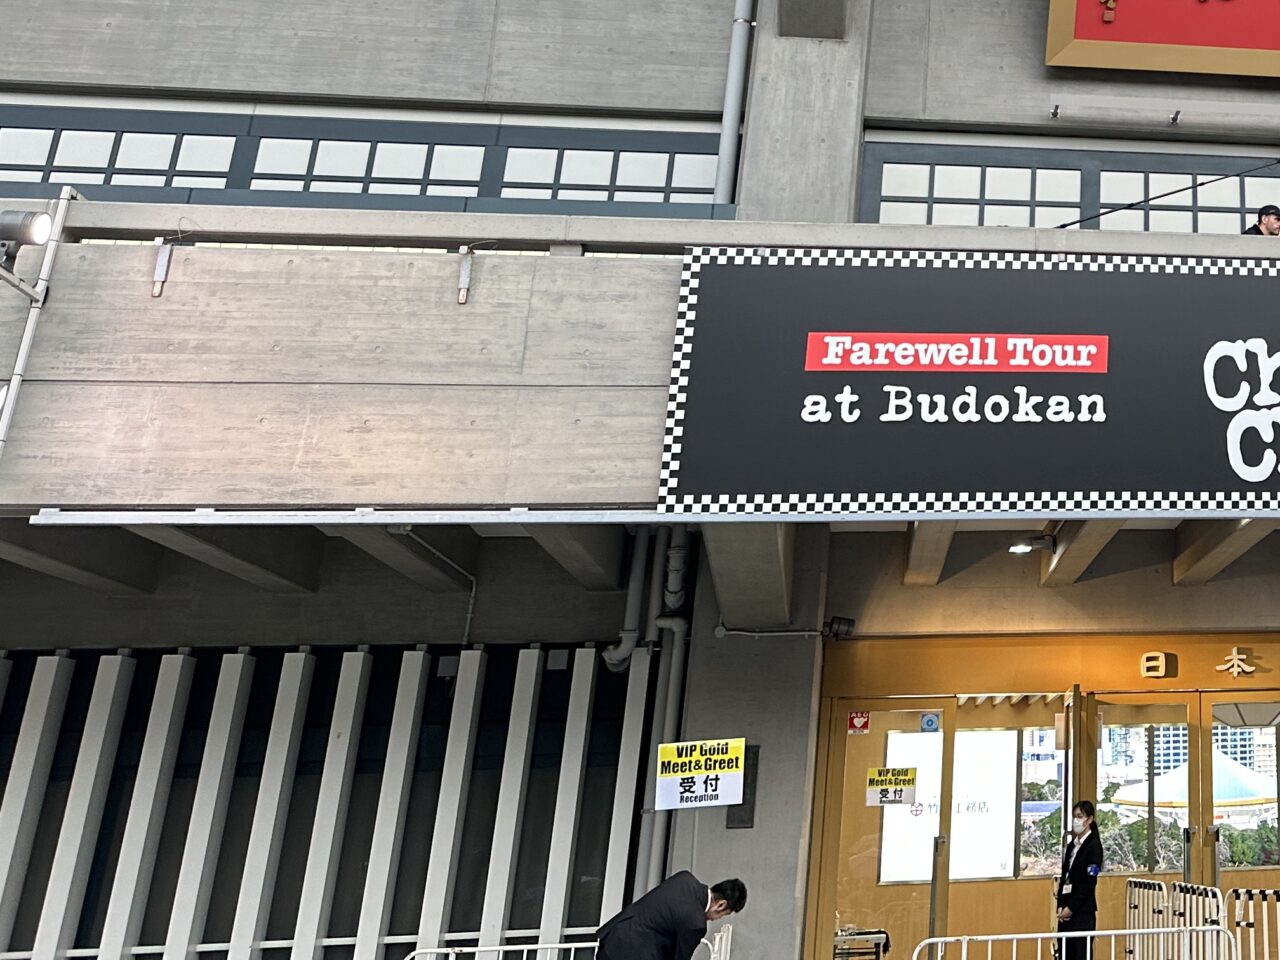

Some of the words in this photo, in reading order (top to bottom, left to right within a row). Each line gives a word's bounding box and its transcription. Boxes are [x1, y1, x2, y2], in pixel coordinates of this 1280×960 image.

[821, 335, 998, 366] Farewell
[1007, 337, 1097, 367] Tour
[801, 385, 861, 423] at
[879, 384, 1107, 423] Budokan
[676, 743, 697, 757] VIP
[700, 742, 729, 756] Gold
[660, 756, 740, 775] Meet&Greet
[877, 769, 889, 777] VIP
[891, 768, 908, 777] Gold
[679, 774, 720, 795] 受付
[679, 792, 719, 805] Reception
[879, 788, 903, 799] 受付
